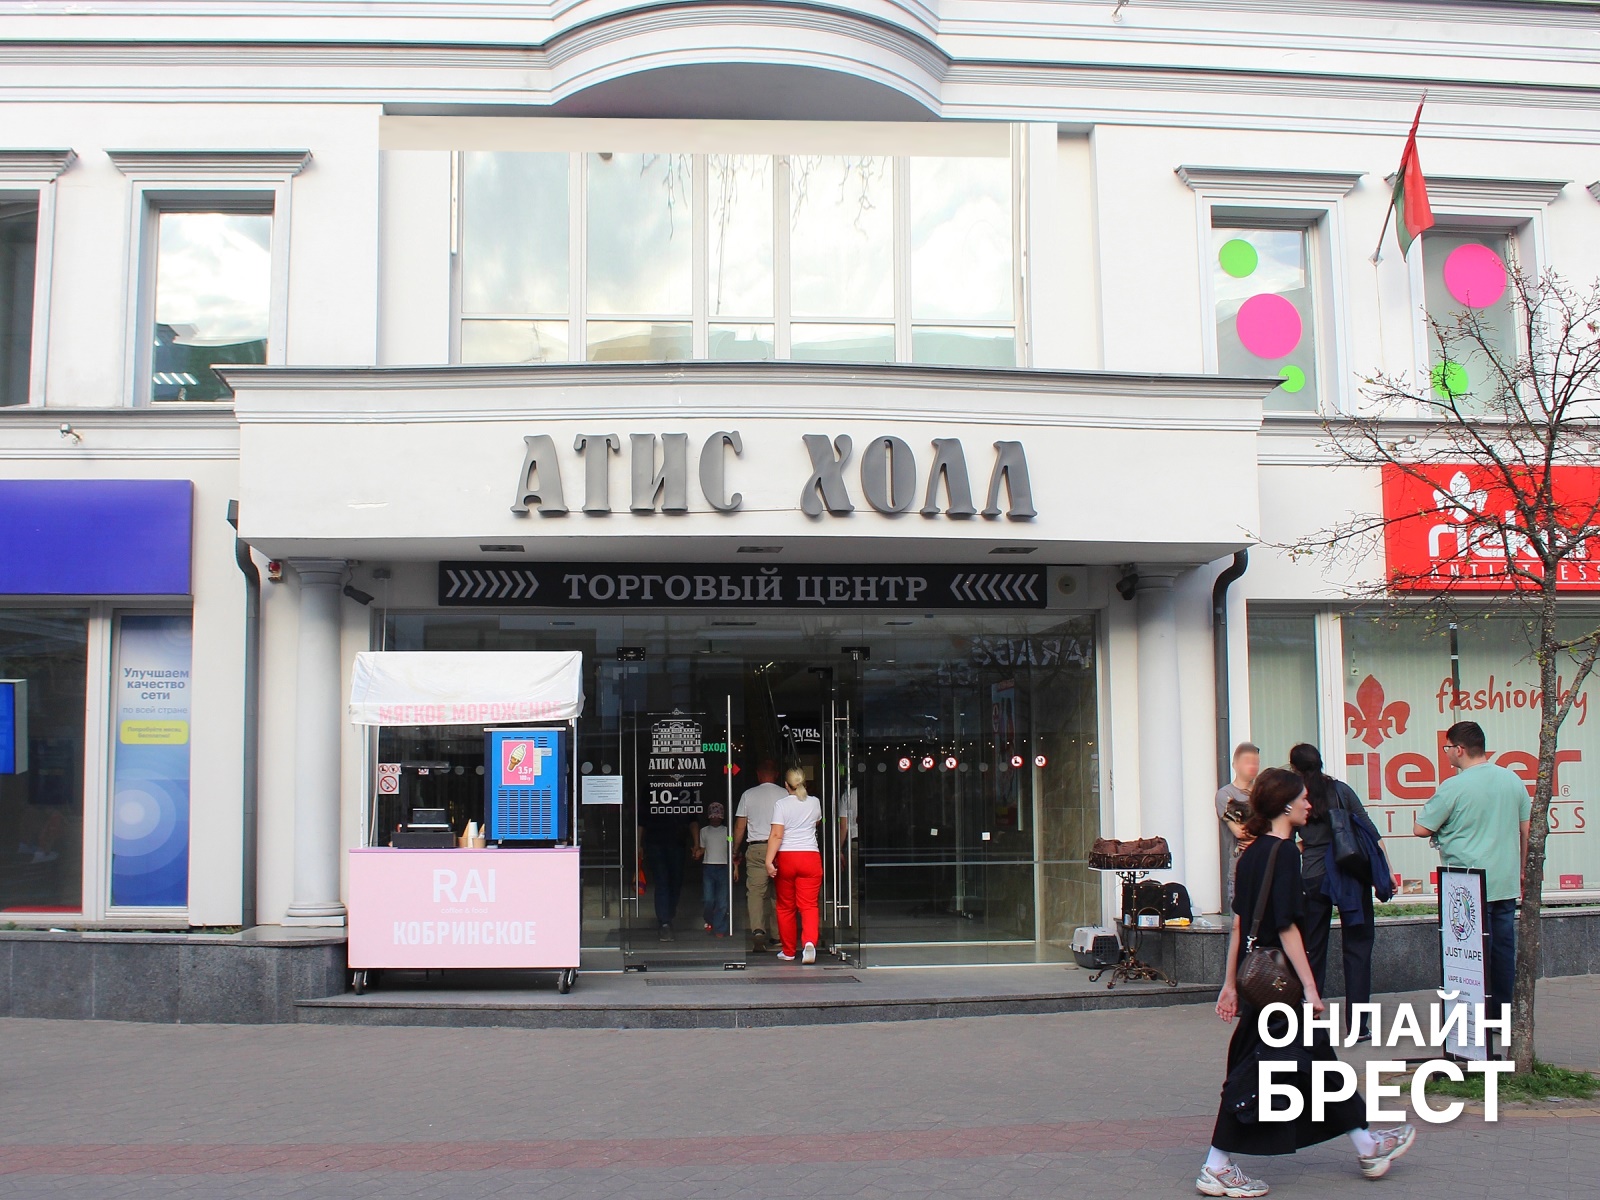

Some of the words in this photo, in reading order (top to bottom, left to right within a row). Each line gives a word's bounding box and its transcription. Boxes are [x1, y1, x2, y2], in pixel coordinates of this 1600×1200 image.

[509, 430, 743, 516] АТИС
[800, 433, 1038, 519] ХОЛЛ
[563, 567, 783, 604] ТОРГОВЫЙ
[796, 576, 928, 606] ЦЕНТР
[124, 667, 190, 680] Улучшаем
[127, 681, 185, 689] качество
[141, 691, 171, 700] сети
[1436, 675, 1545, 714] fashion
[135, 705, 156, 714] всей
[157, 707, 188, 715] стране
[378, 704, 447, 724] МЯГКОЕ
[452, 700, 562, 722] МОРОЖЕНОЕ
[702, 743, 727, 752] ВХОД
[648, 758, 675, 770] АТИС
[677, 758, 706, 770] ХОЛЛ
[649, 790, 703, 804] 10-21
[432, 868, 496, 903] RAI
[393, 921, 537, 945] КОБРИНСКОЕ
[1445, 947, 1462, 957] JUST
[1463, 949, 1482, 961] VAPE
